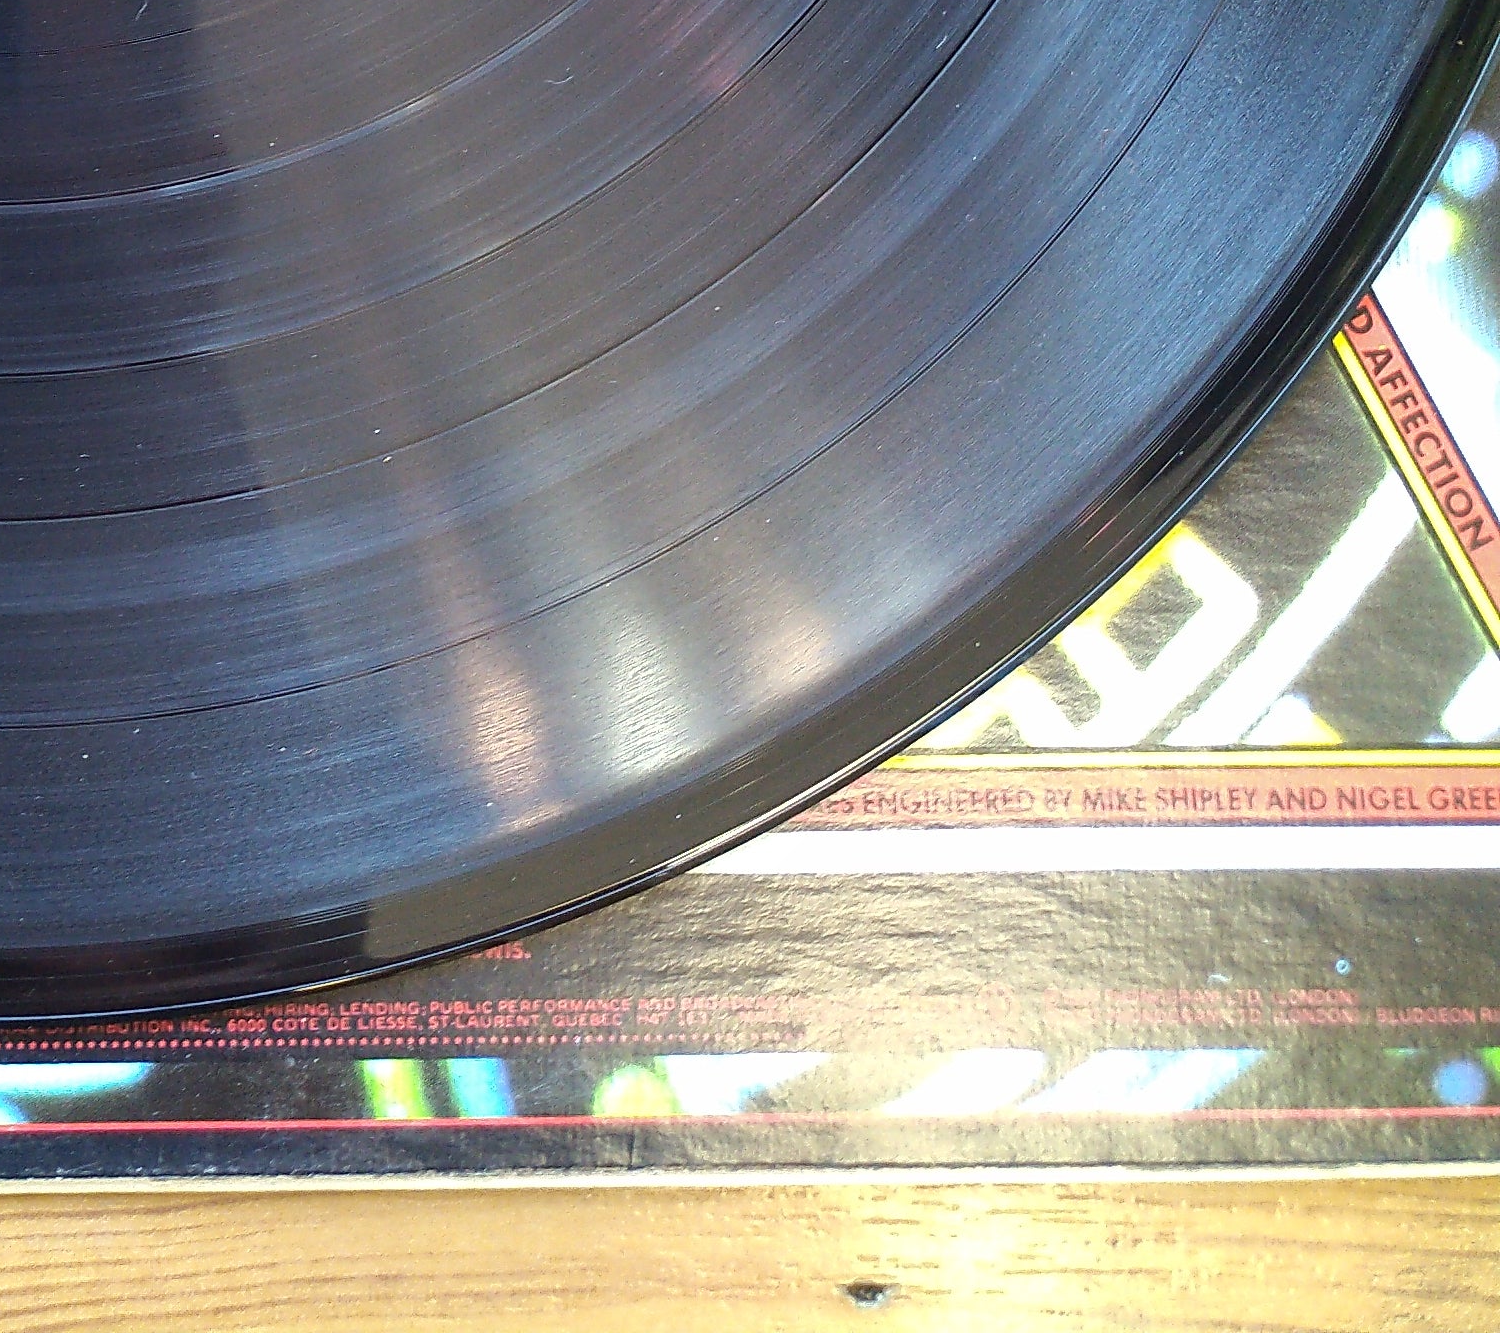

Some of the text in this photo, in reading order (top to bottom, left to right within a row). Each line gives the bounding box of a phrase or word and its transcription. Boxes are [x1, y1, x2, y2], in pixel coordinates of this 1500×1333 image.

[1362, 347, 1494, 551] AFFECTION
[1154, 787, 1256, 812] SHIPLEY
[1266, 786, 1327, 811] AND
[1336, 786, 1420, 811] NIGEL
